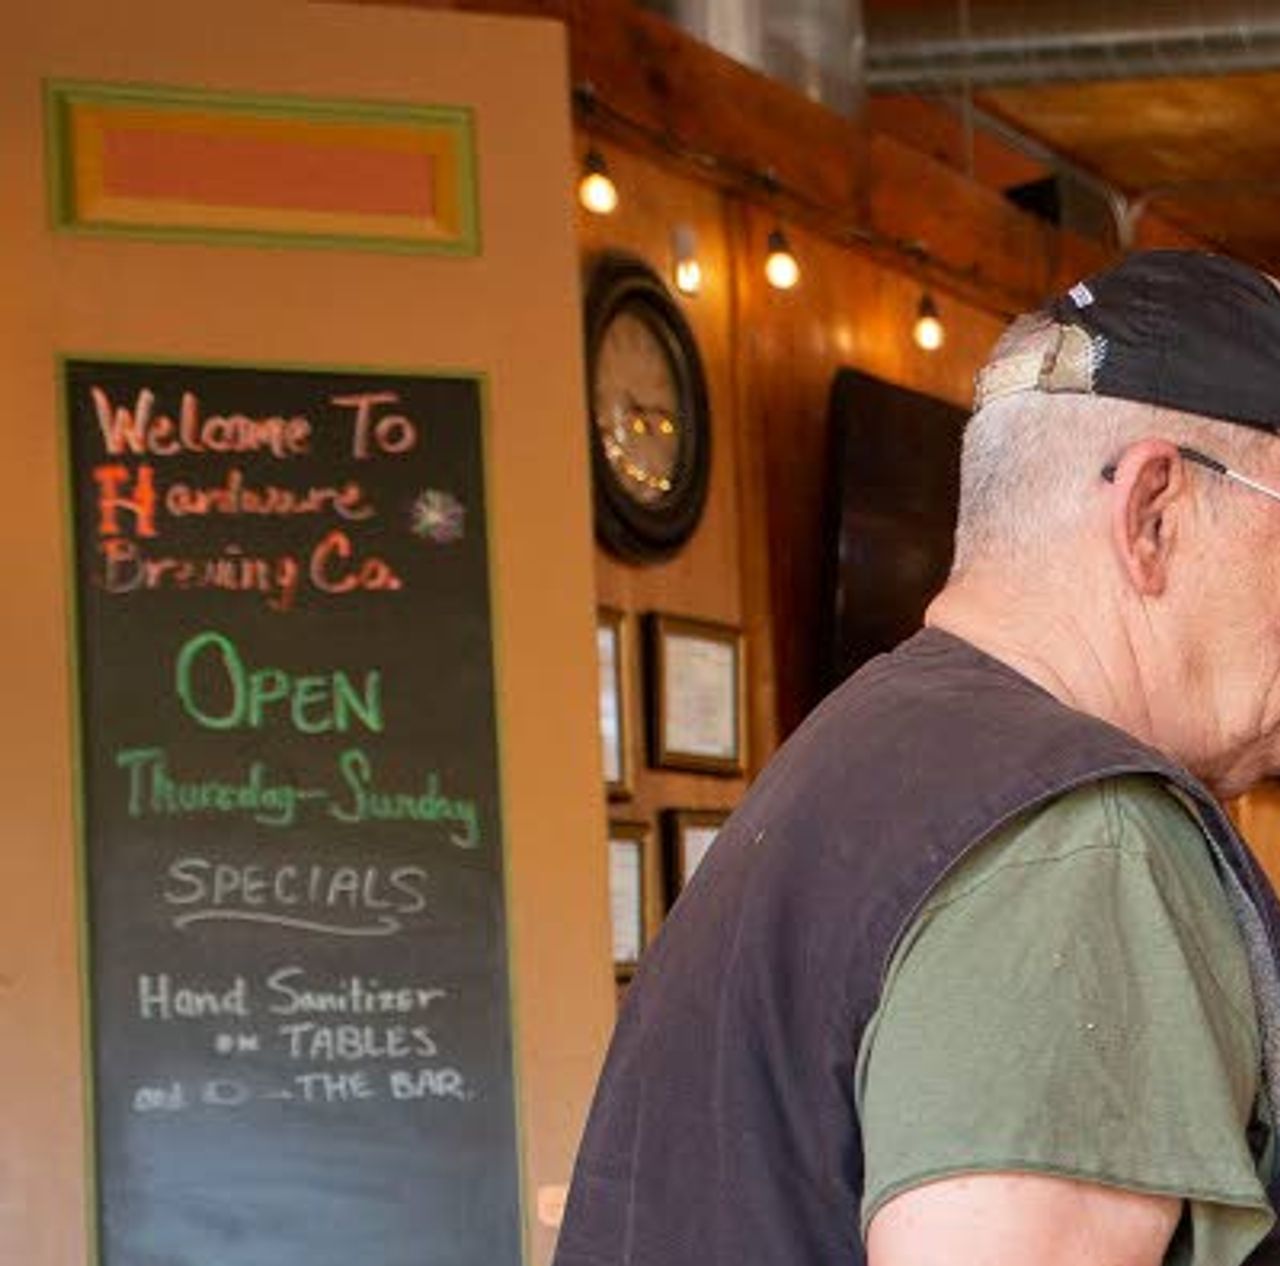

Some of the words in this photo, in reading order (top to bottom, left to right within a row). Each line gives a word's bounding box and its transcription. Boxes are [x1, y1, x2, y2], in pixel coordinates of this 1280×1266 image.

[92, 386, 312, 458] Welcome
[331, 392, 418, 459] To
[310, 529, 402, 593] Co.
[177, 632, 384, 732] OPEN
[164, 858, 428, 914] SPECIALS
[138, 974, 252, 1020] Hand
[267, 967, 446, 1016] Sanitizer
[280, 1021, 437, 1060] TABLES
[294, 1072, 374, 1102] THE
